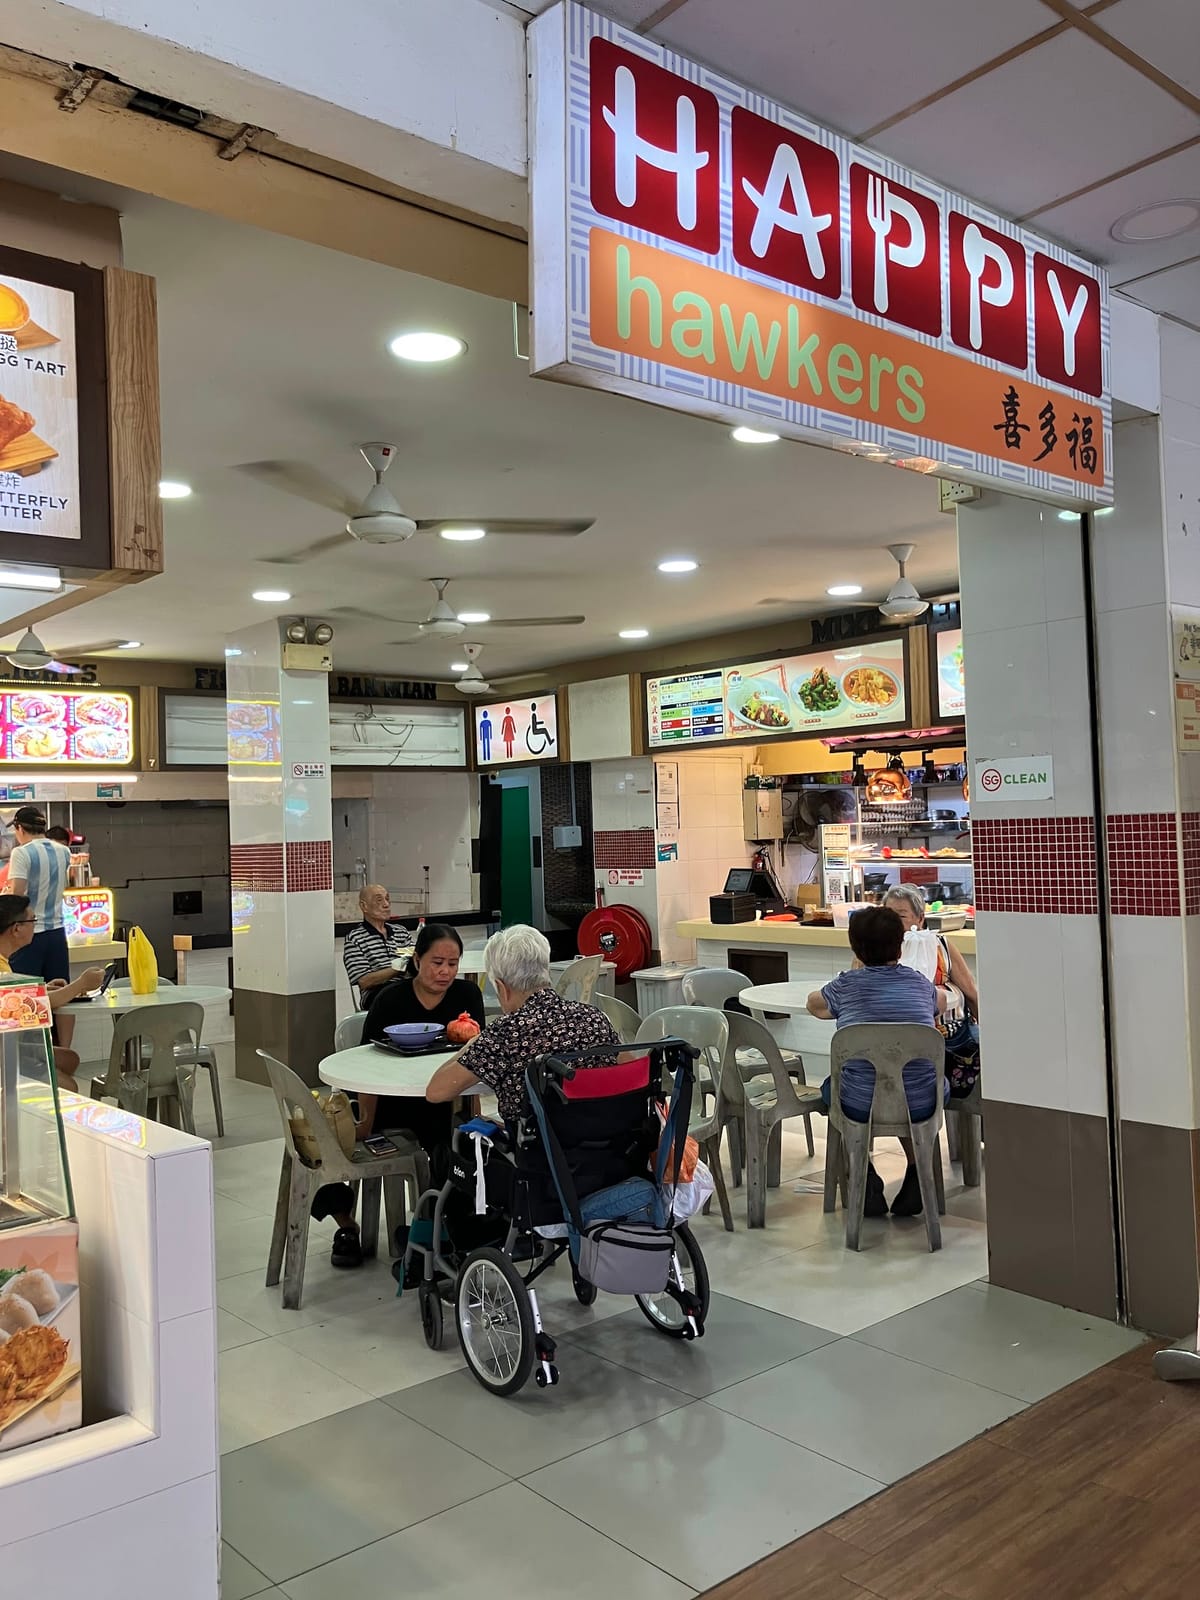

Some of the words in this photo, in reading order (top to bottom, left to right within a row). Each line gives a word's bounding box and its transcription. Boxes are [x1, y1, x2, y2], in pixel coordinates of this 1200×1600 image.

[602, 65, 1088, 376] HAPPY
[616, 244, 925, 423] hawkers
[24, 357, 67, 376] TART
[993, 385, 1097, 474] 喜多福
[1, 505, 42, 520] TTER
[149, 759, 156, 767] 7
[984, 775, 999, 786] SG
[1003, 772, 1047, 785] CLEAN
